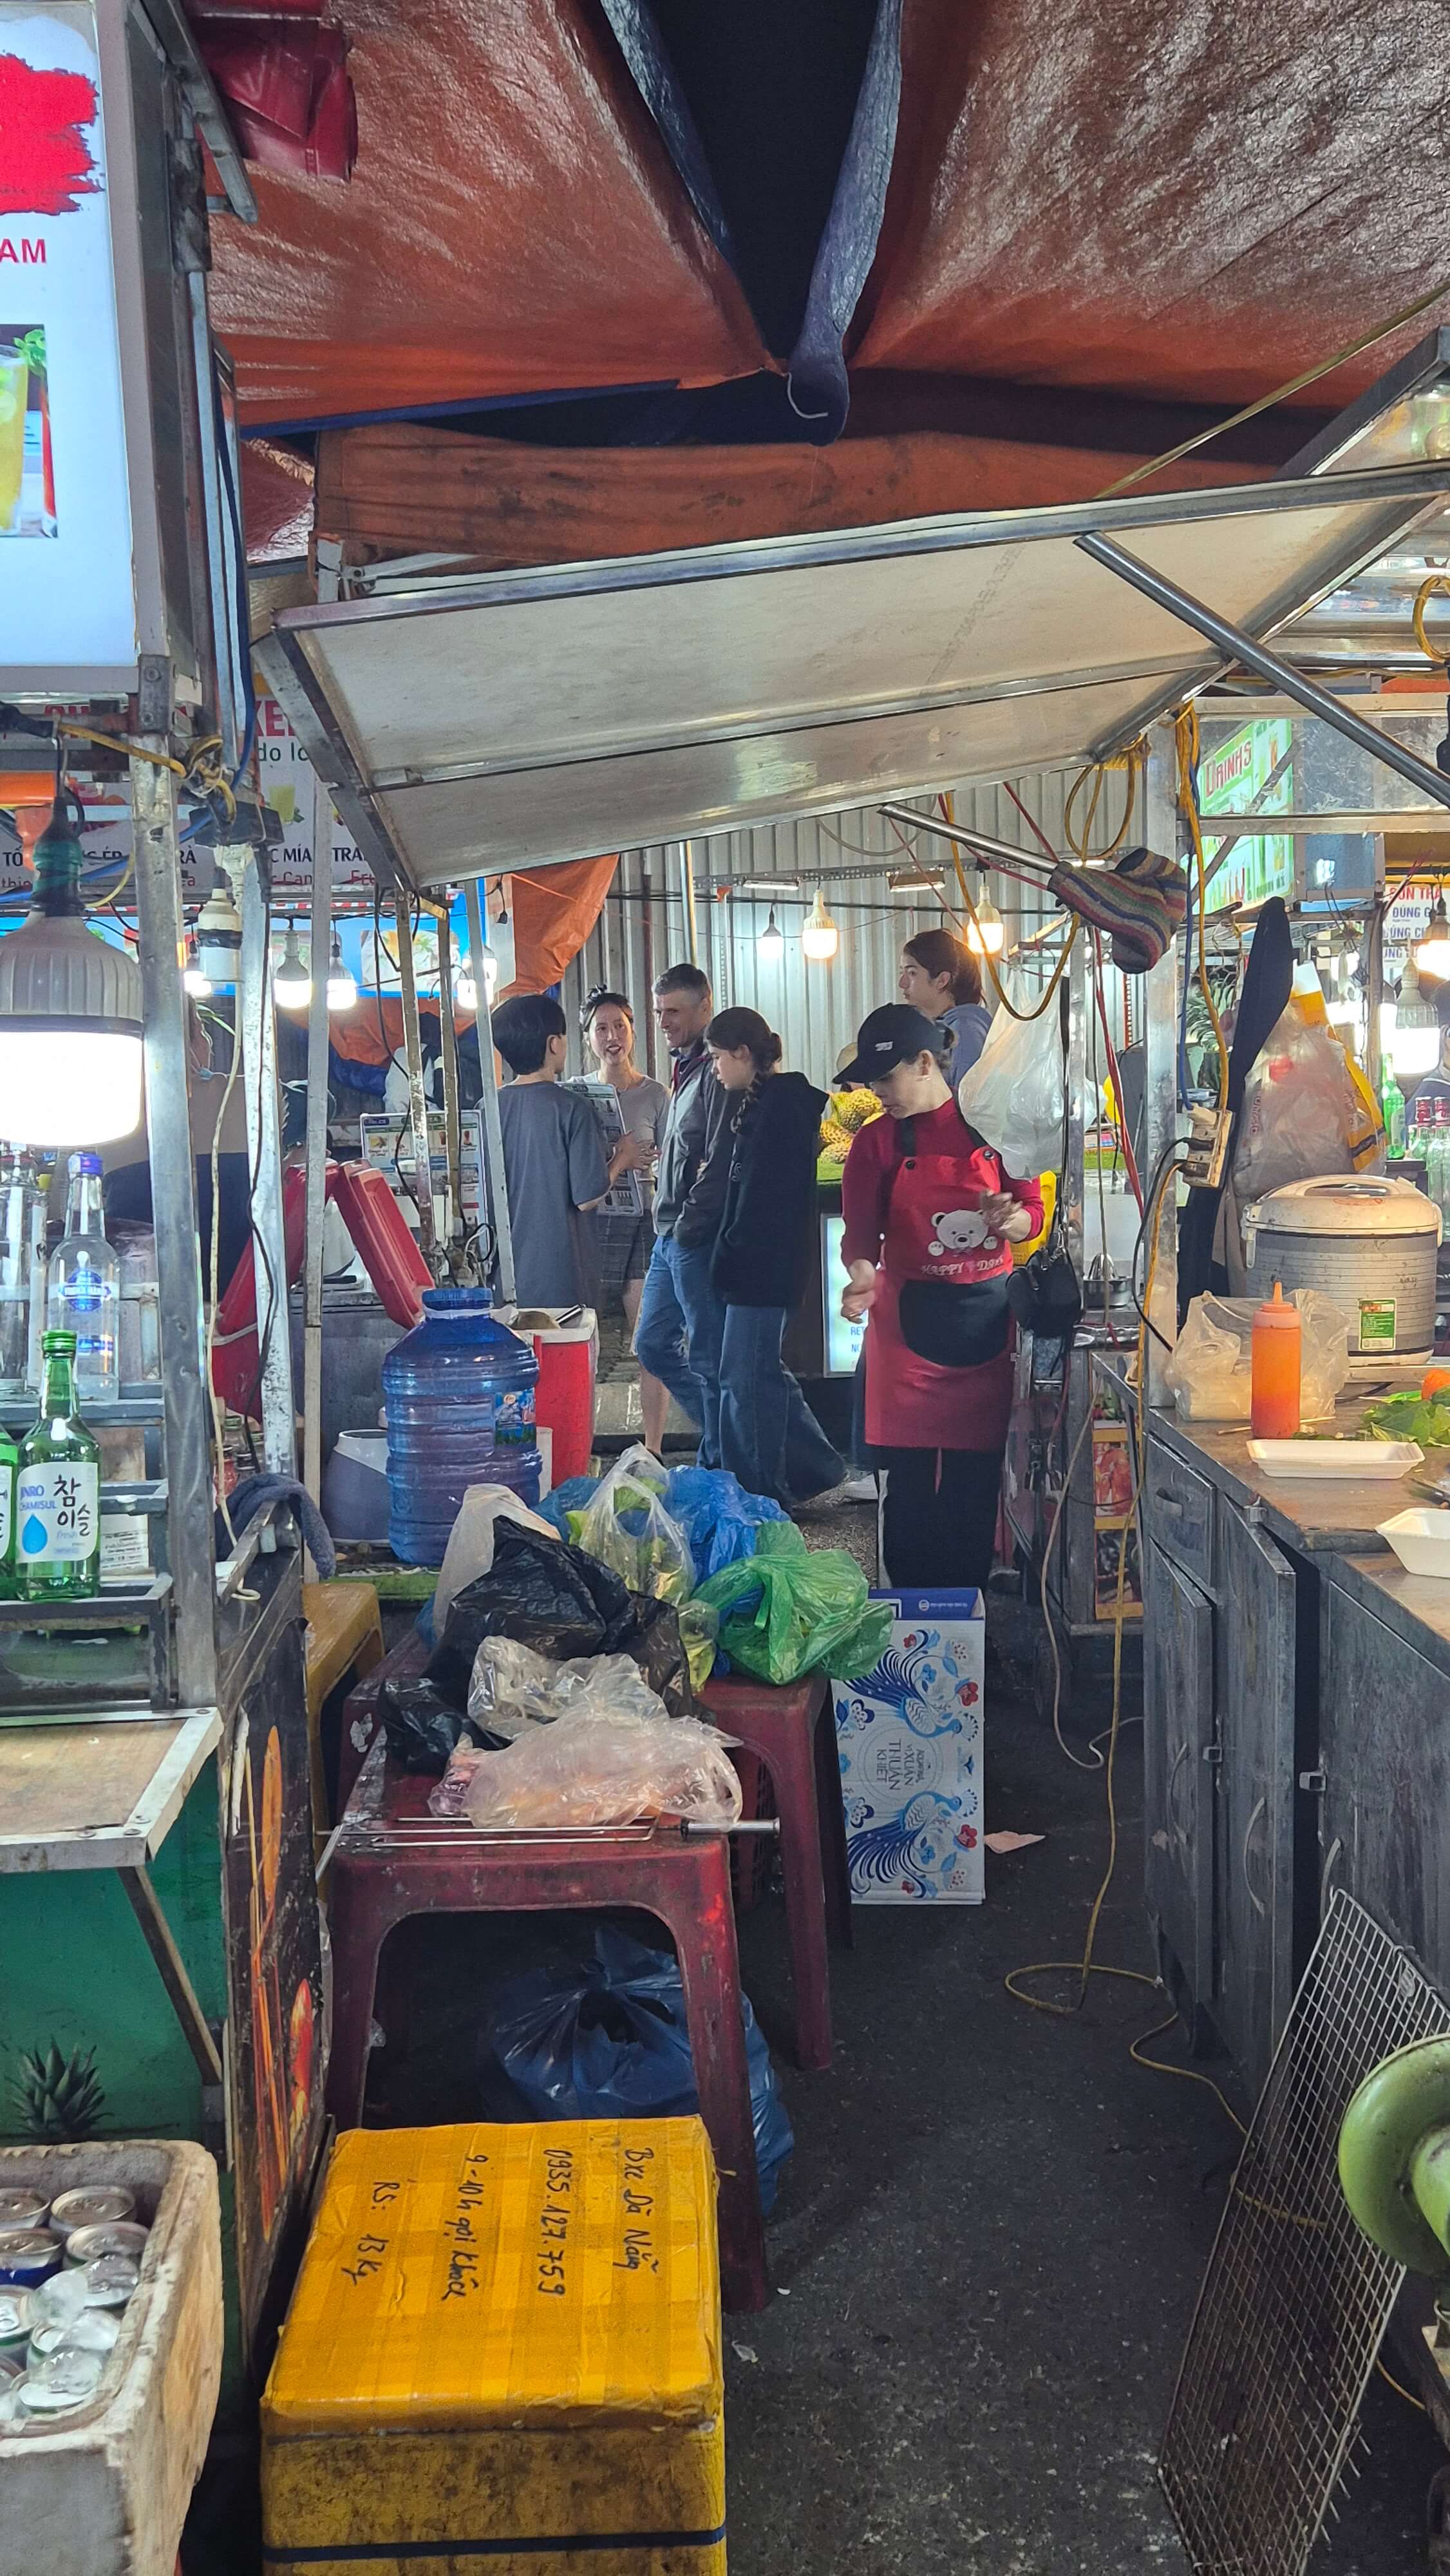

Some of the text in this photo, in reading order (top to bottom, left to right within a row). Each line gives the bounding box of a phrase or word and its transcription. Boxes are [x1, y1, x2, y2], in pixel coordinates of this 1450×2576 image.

[283, 844, 313, 862] MÍA
[332, 847, 367, 862] TRA
[921, 1262, 965, 1276] HAPPY
[53, 1473, 82, 1508] 참
[57, 1504, 91, 1537] 이슬
